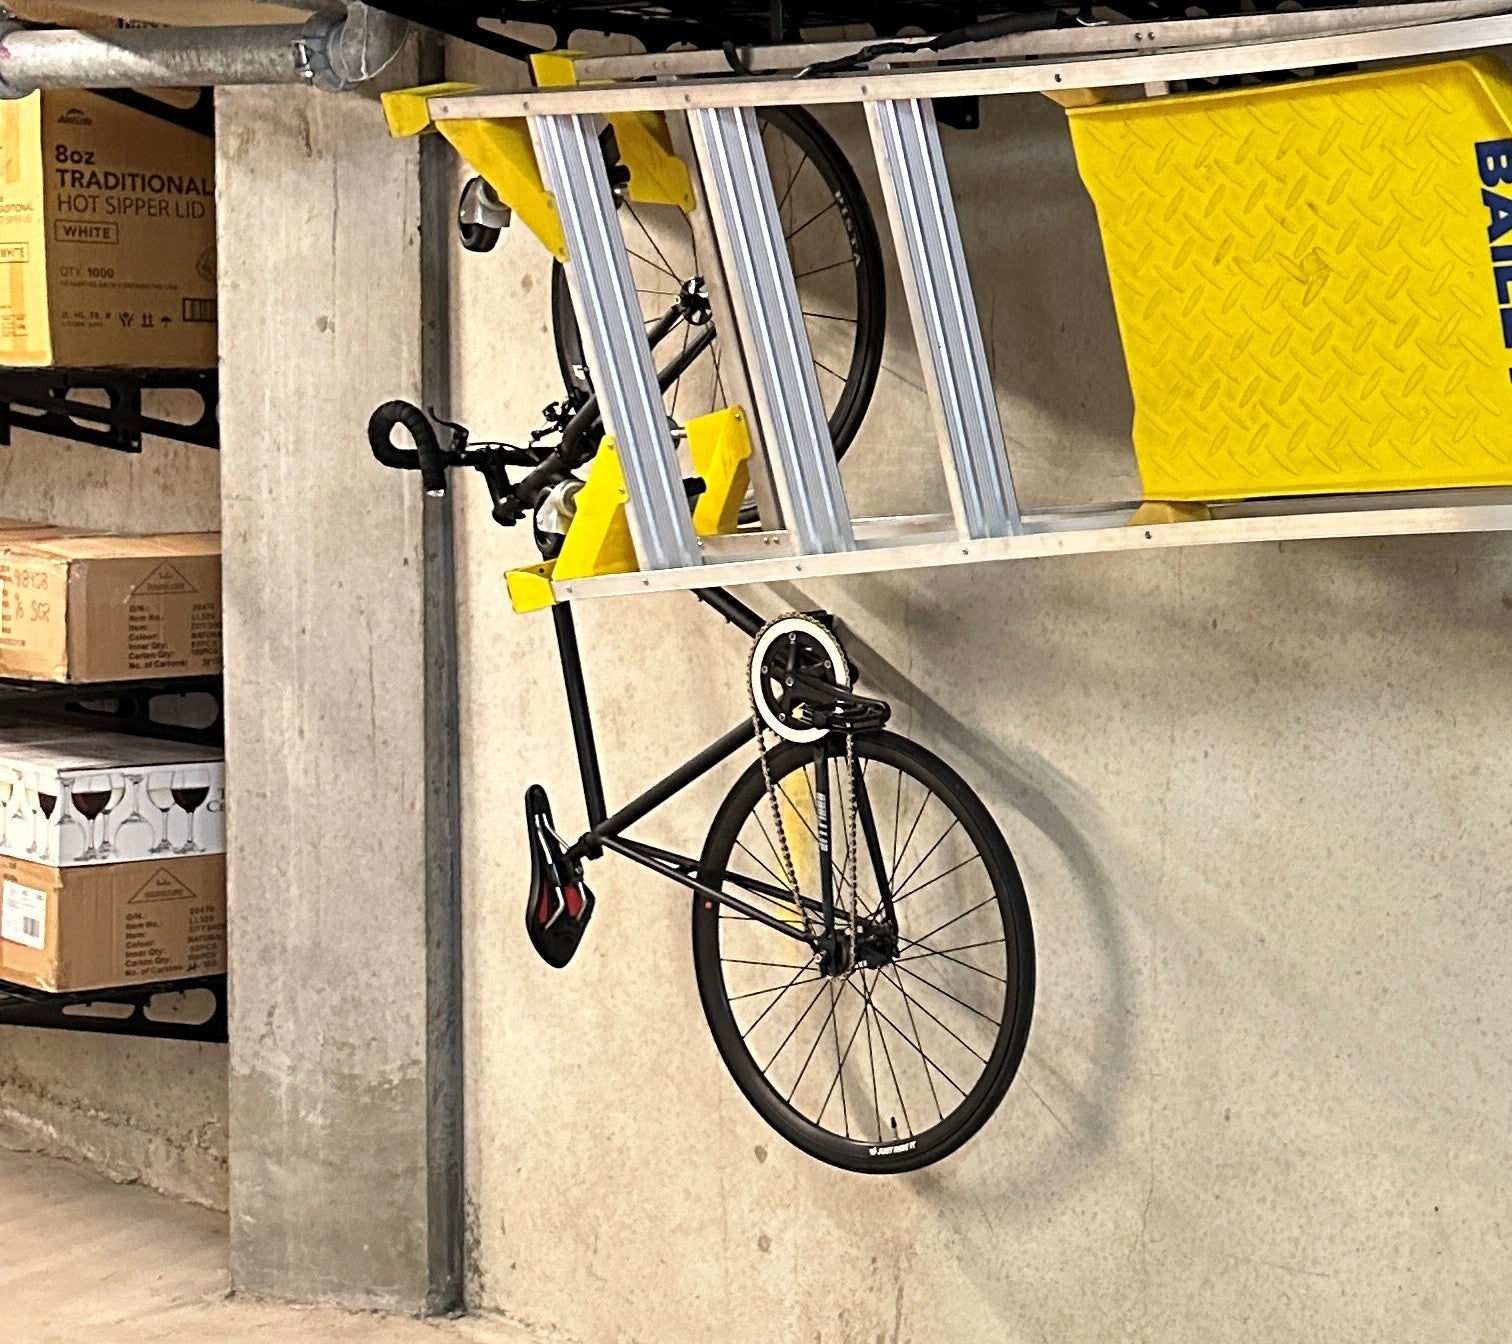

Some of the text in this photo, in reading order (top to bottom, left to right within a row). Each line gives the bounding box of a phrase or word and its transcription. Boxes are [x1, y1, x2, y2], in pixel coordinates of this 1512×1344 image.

[55, 144, 96, 165] 8oz
[55, 168, 215, 197] TRADITIONAL
[57, 193, 206, 219] HOT SIPPER LID
[63, 225, 111, 239] WHITE
[87, 267, 115, 279] 1000
